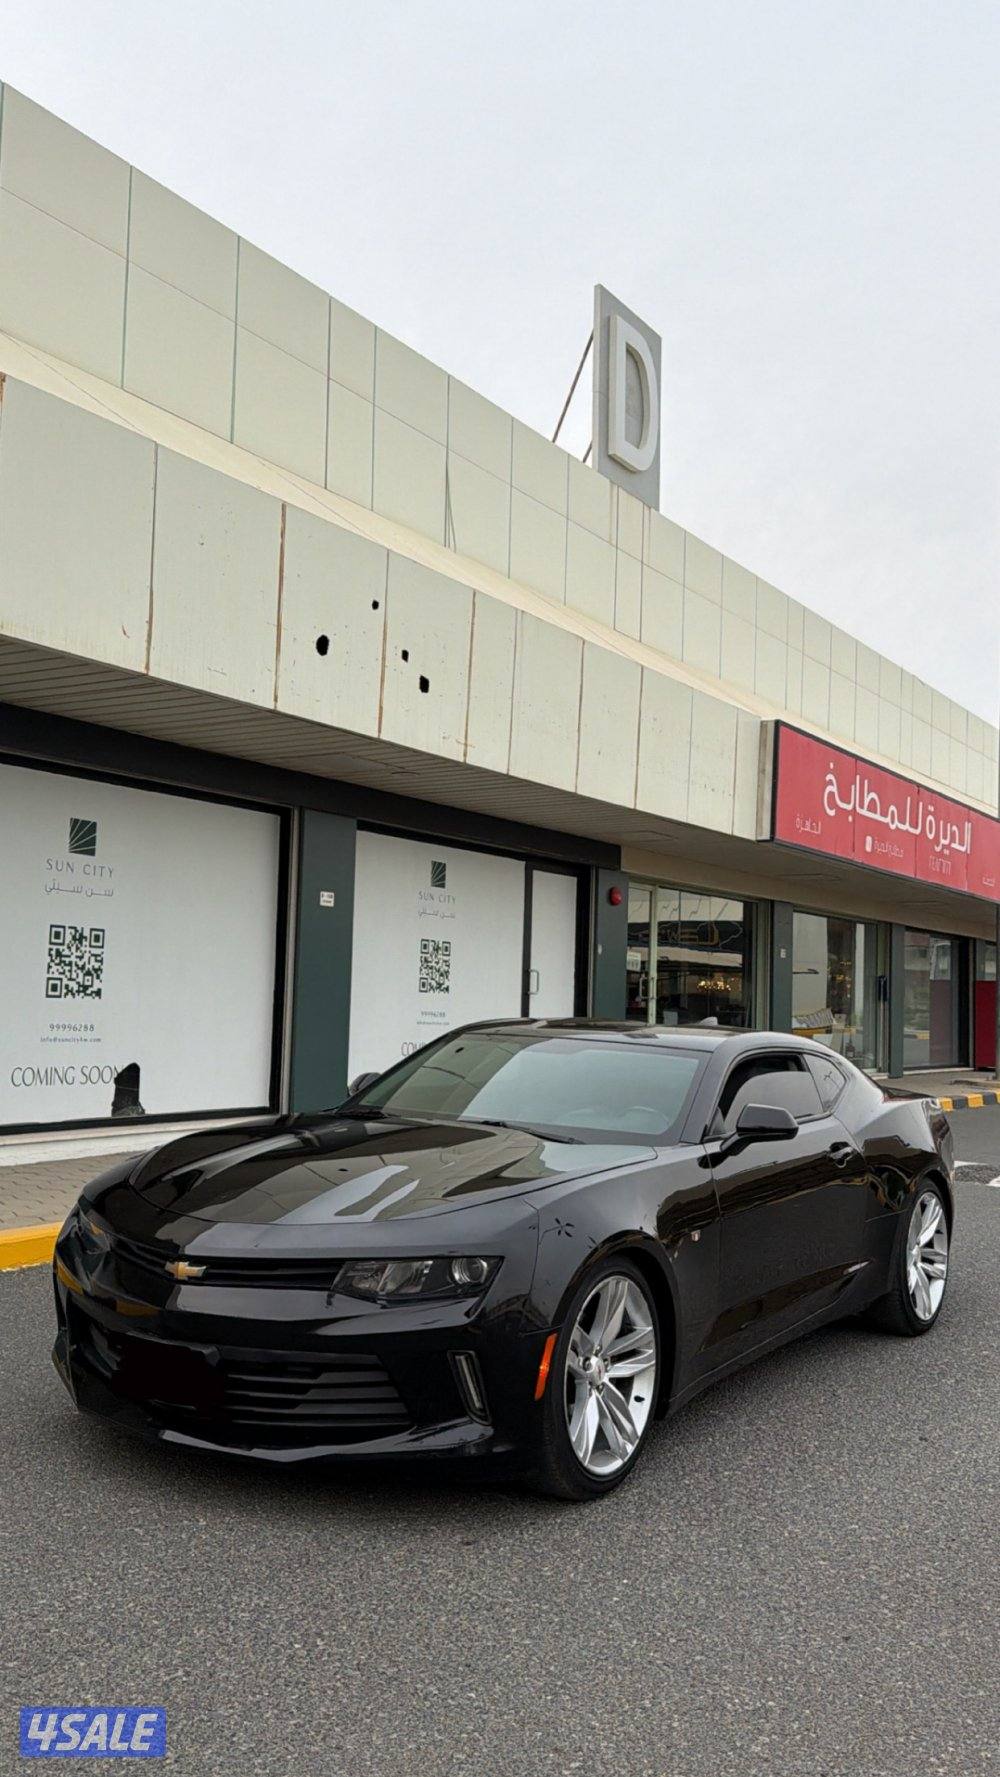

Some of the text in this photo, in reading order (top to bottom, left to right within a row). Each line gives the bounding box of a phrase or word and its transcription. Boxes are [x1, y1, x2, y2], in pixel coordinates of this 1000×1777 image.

[608, 314, 659, 471] D
[823, 762, 972, 855] الديرة للمطابخ
[46, 858, 114, 878] SUN CITY
[49, 1023, 95, 1033] 99996288
[11, 1065, 76, 1087] COMING
